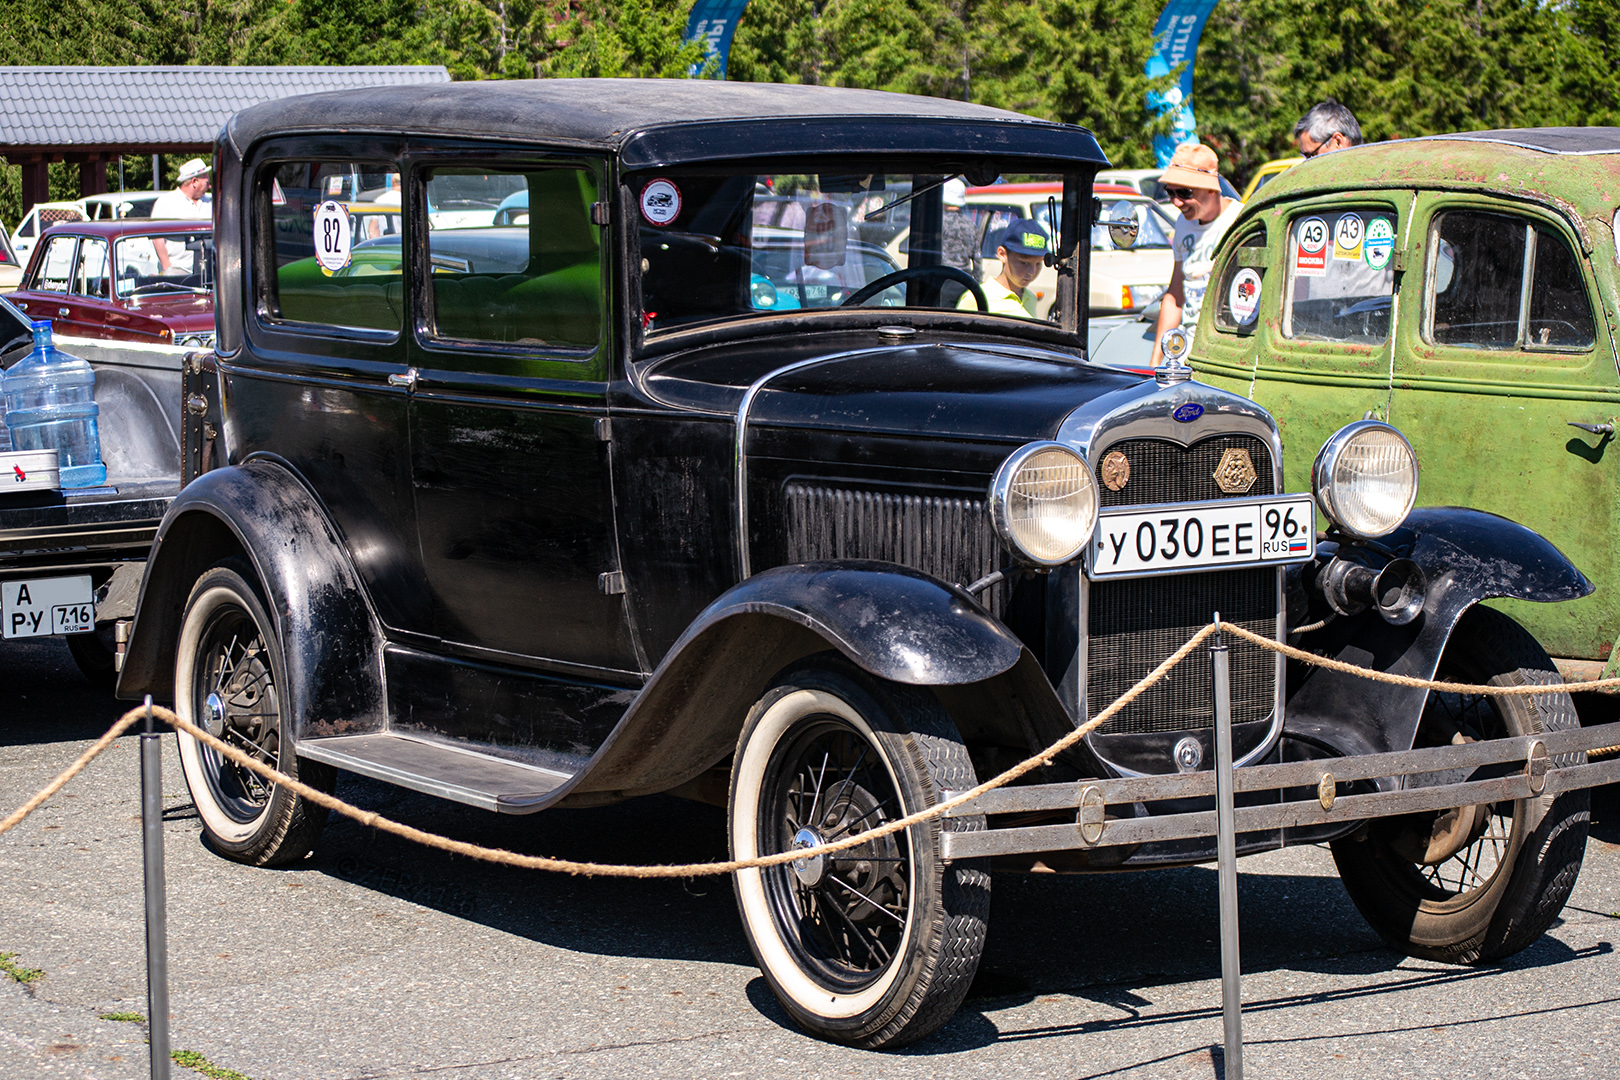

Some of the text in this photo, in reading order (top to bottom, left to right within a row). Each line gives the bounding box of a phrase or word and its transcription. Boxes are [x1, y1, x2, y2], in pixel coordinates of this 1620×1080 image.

[1170, 15, 1197, 66] HILLS
[323, 217, 342, 253] 82
[1303, 225, 1323, 243] АЭ
[1340, 219, 1359, 239] АЭ
[1298, 256, 1324, 265] МОСКВА
[1177, 406, 1200, 418] Ford
[1265, 507, 1299, 540] 96
[1263, 540, 1288, 553] RUS
[16, 583, 33, 606] А
[57, 605, 90, 625] 716
